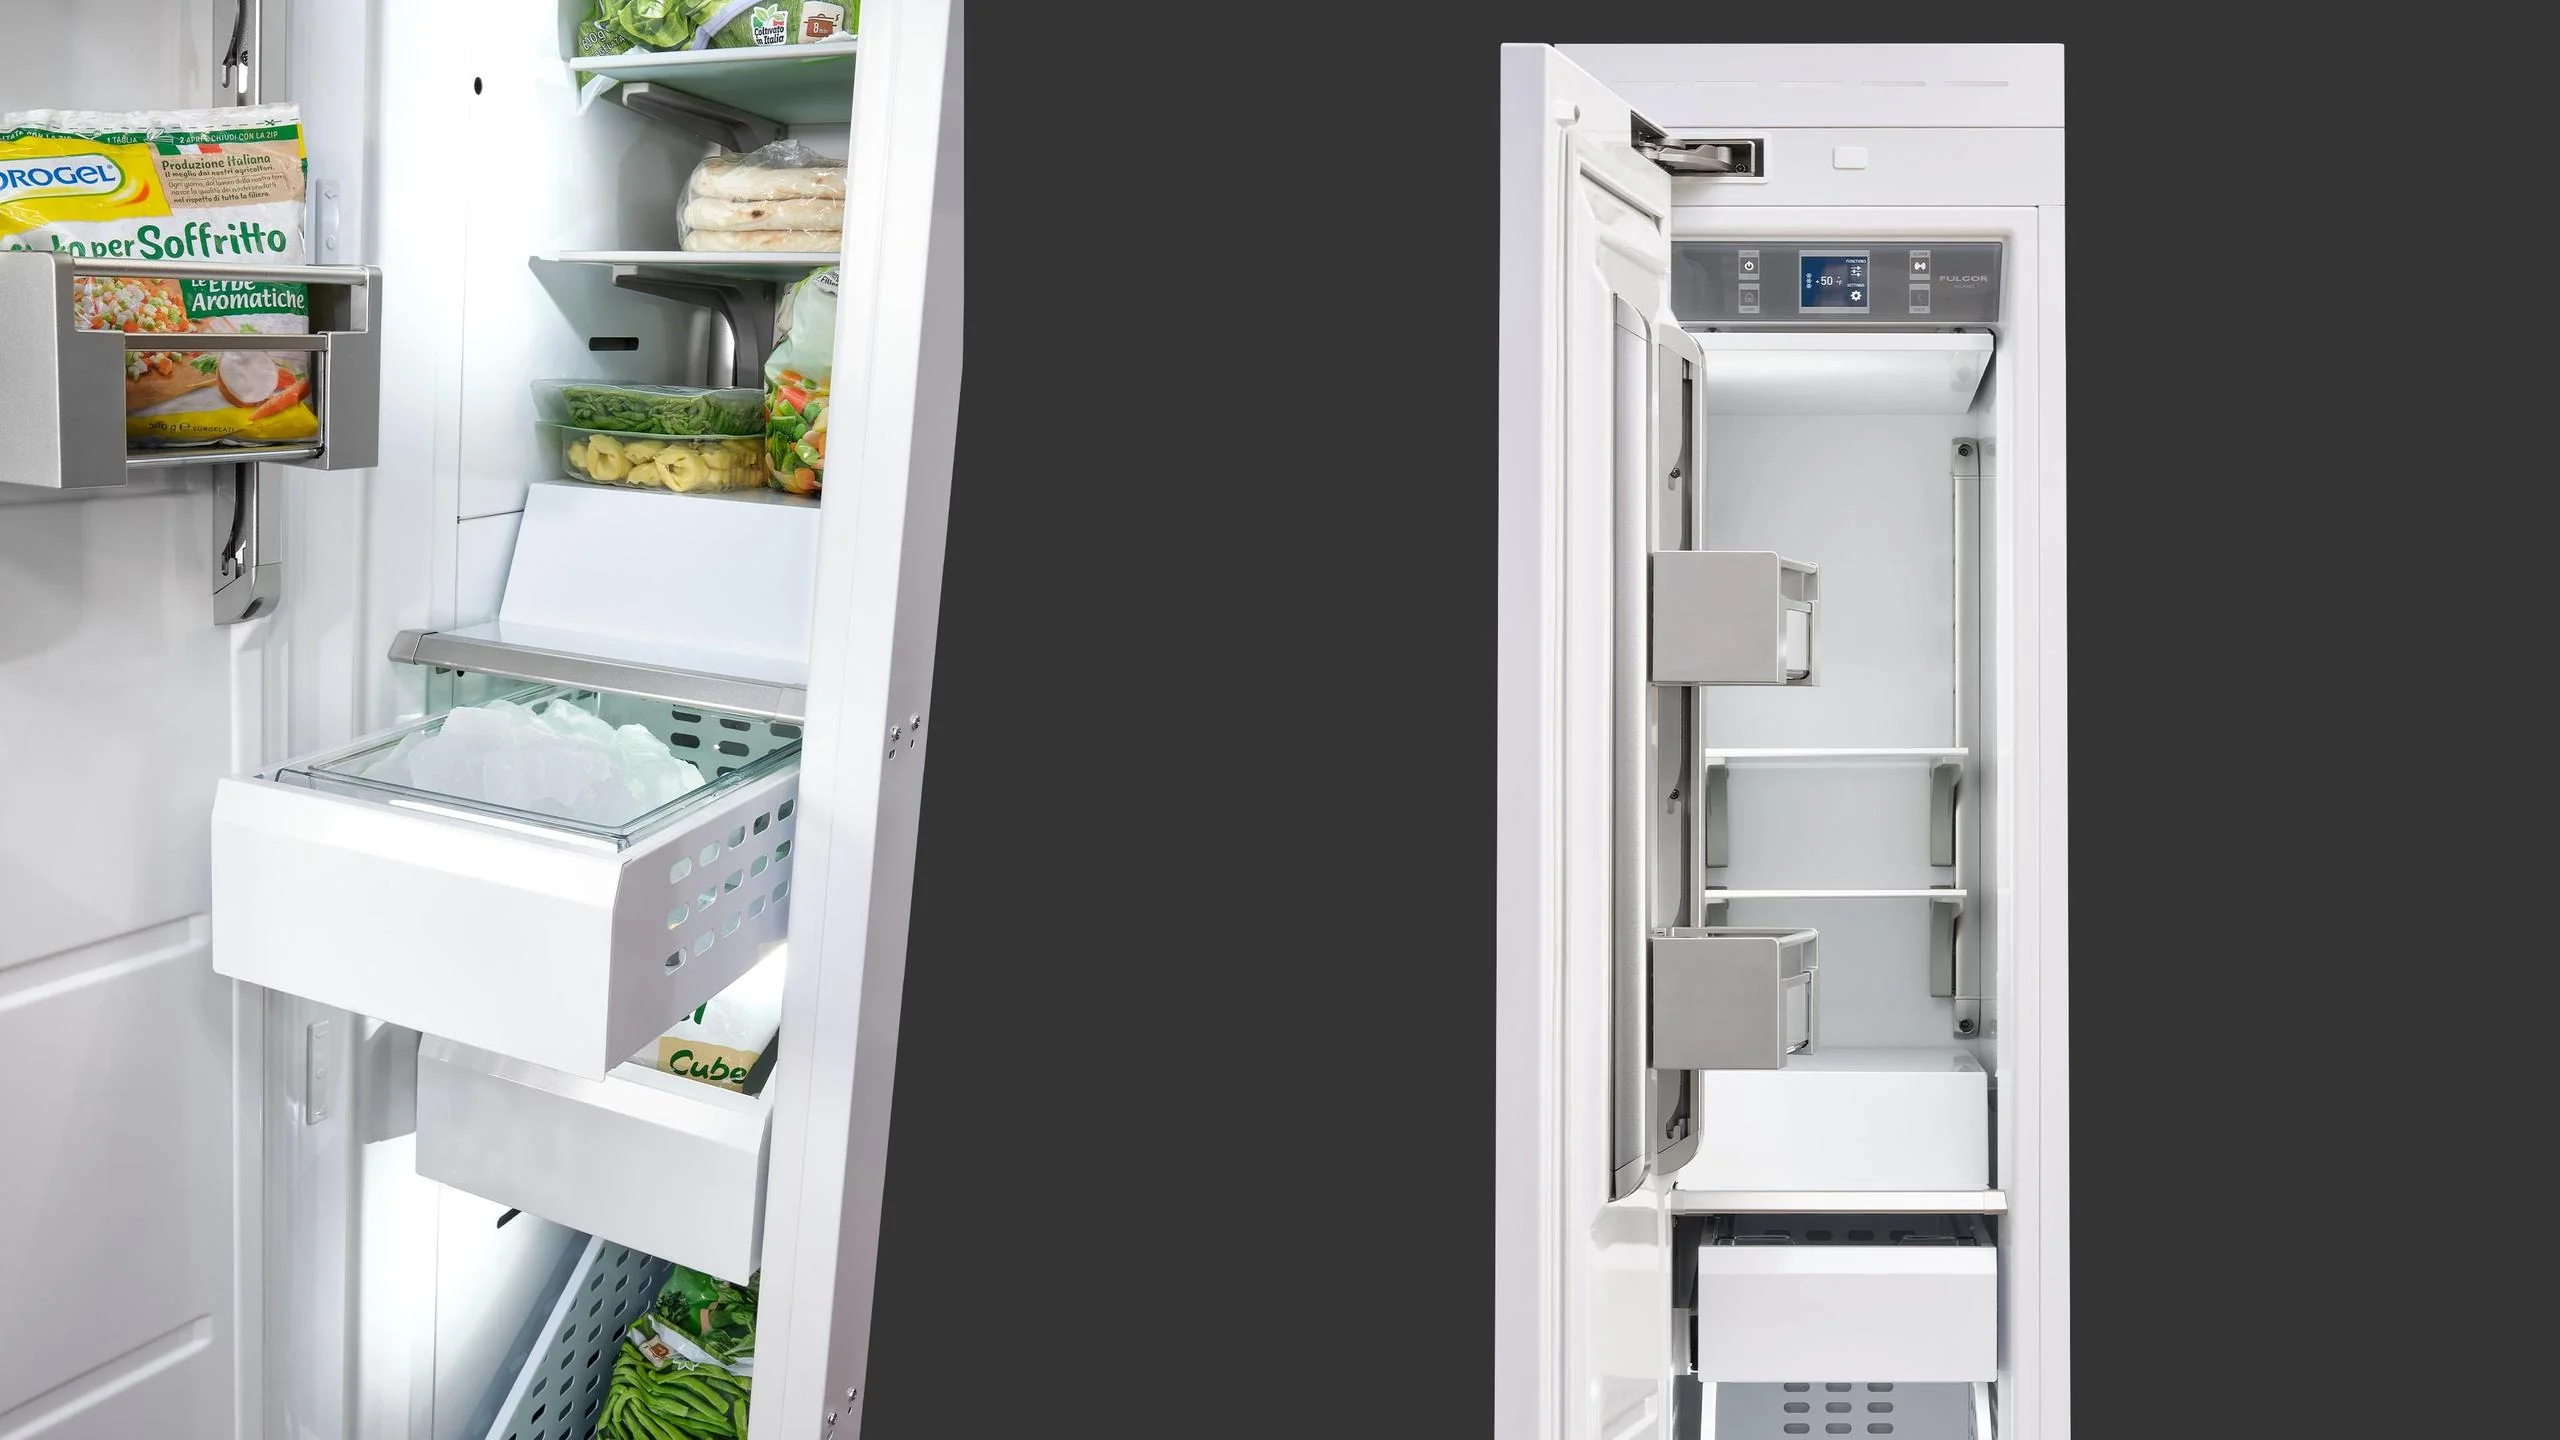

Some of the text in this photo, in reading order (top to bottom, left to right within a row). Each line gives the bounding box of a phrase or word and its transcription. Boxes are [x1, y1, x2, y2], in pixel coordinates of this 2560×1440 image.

[754, 25, 785, 36] Coltivato
[813, 22, 819, 33] 8
[756, 34, 784, 45] in Italia
[112, 135, 138, 144] TAGLIA
[211, 133, 237, 142] CHIUDI
[238, 132, 255, 141] CON
[256, 131, 265, 140] LA
[266, 130, 279, 139] ZIP
[161, 158, 225, 171] Produzione
[172, 170, 197, 179] meglio
[198, 169, 210, 177] dai
[211, 167, 233, 176] nostri
[185, 195, 212, 204] rispetto
[221, 193, 239, 201] tutta
[91, 238, 135, 258] per
[137, 221, 287, 260] Soffritto
[191, 289, 305, 313] Aromatiche
